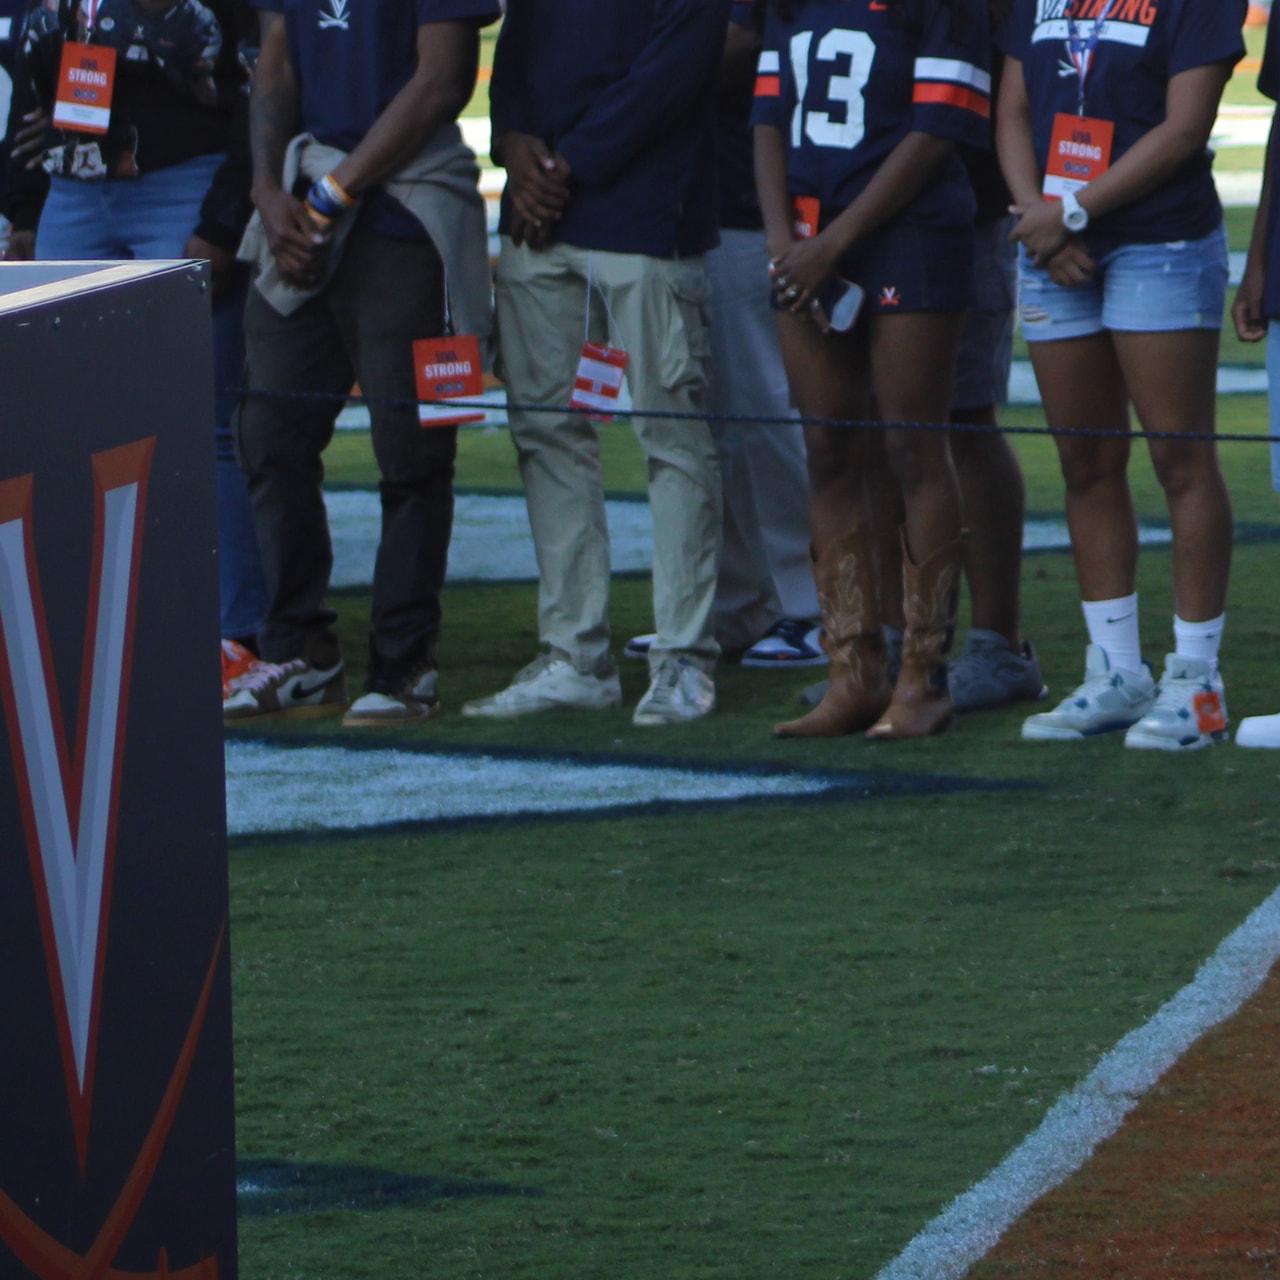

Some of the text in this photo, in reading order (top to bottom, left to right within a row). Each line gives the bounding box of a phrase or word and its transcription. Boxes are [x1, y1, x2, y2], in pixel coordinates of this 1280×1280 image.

[68, 67, 107, 87] STRONG
[789, 28, 877, 150] 13
[1058, 140, 1102, 161] STRONG
[425, 361, 472, 379] STRONG
